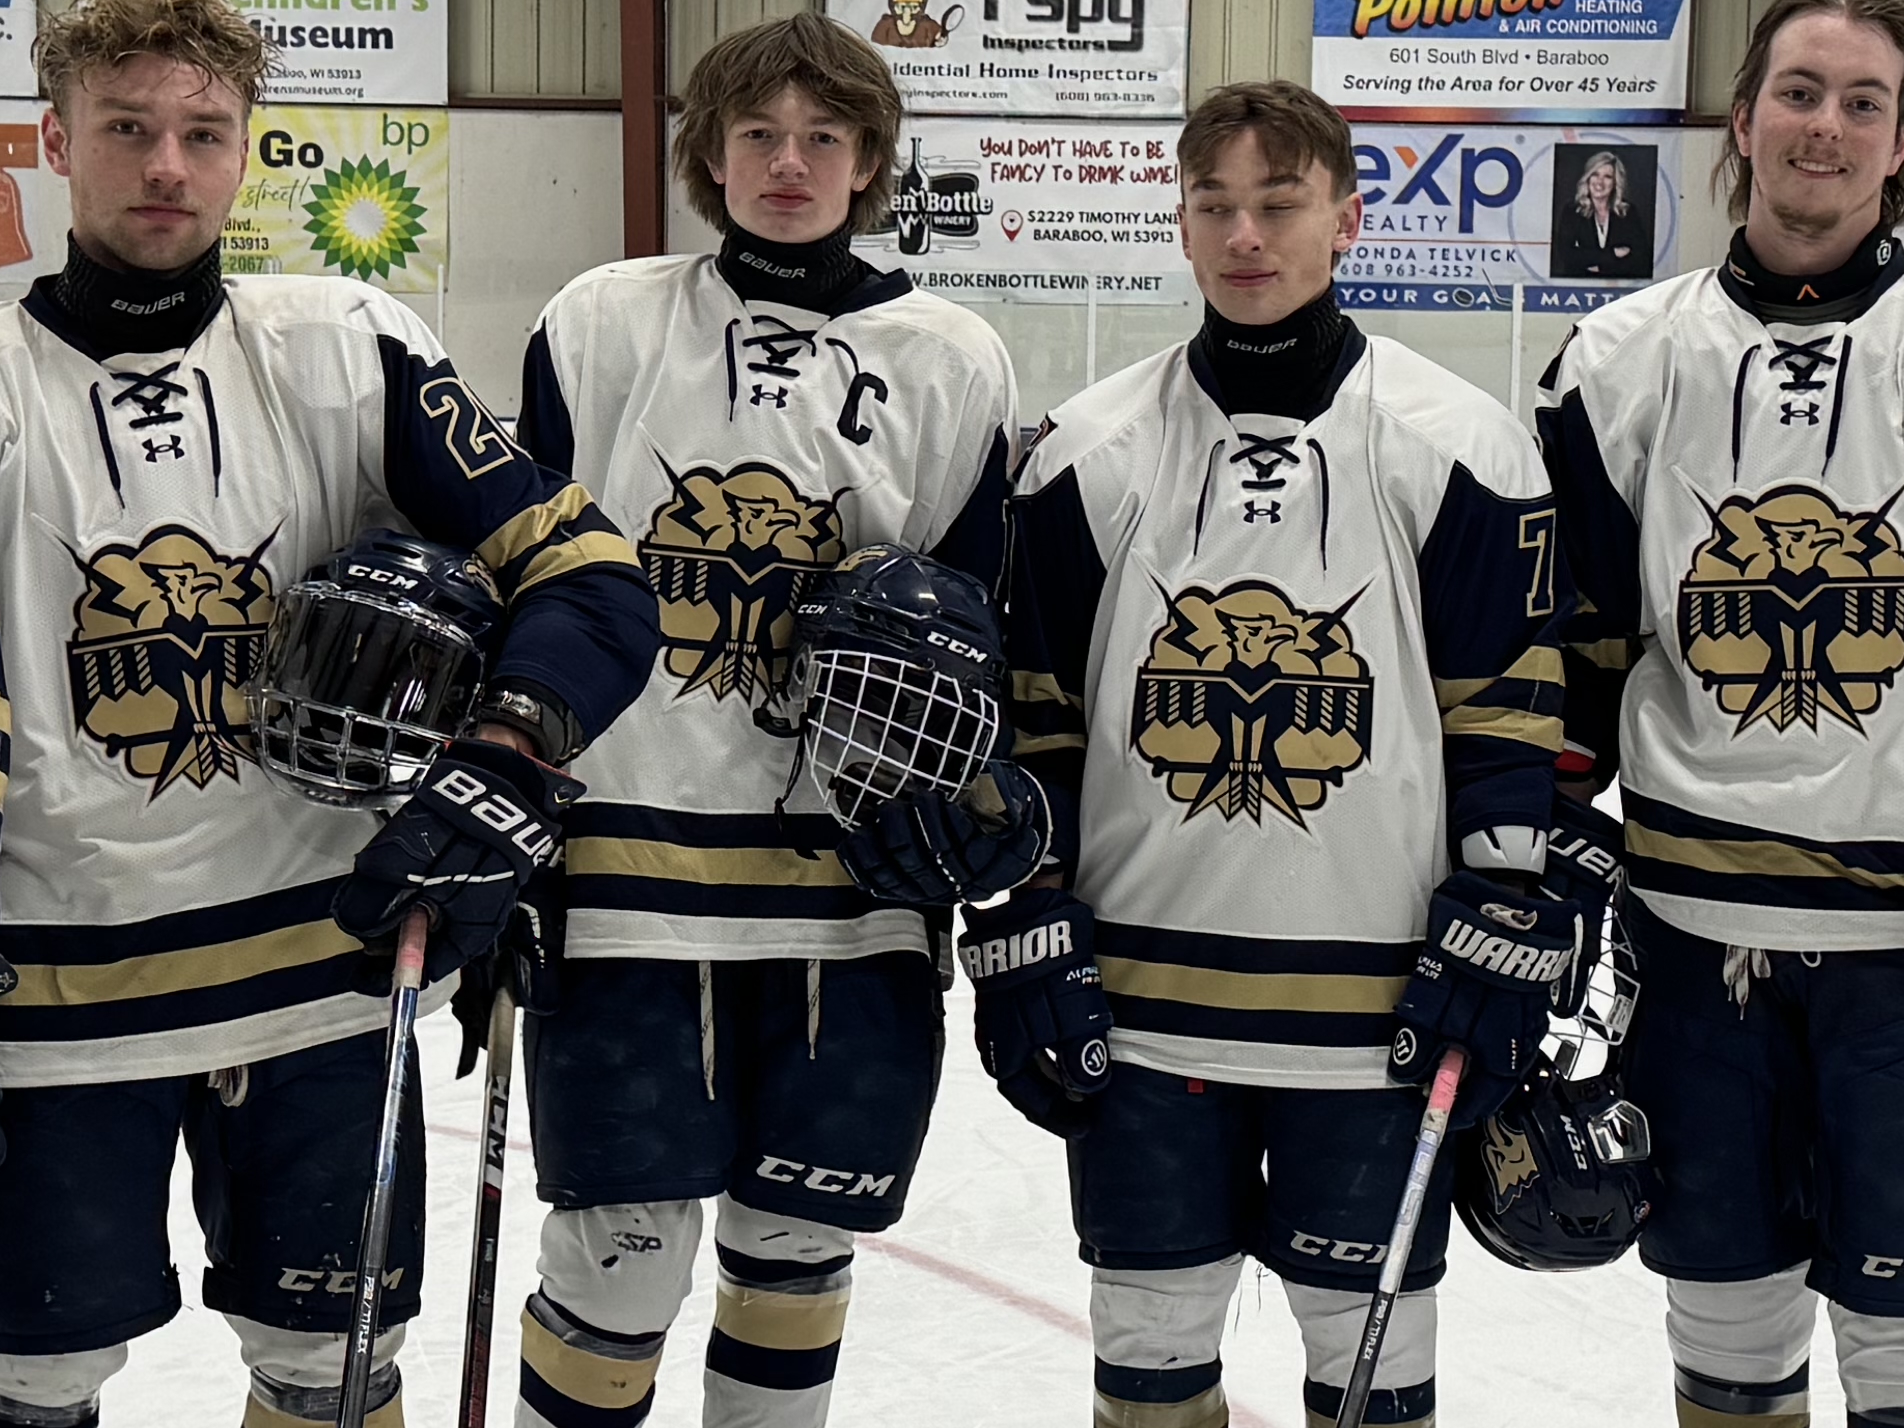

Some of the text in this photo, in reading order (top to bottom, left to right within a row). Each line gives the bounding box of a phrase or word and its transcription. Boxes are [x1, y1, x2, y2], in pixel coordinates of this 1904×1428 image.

[1575, 0, 1643, 14] HEATING
[1498, 19, 1658, 35] & AIR CONDITIONING
[982, 34, 1108, 52] Inspectors
[1389, 48, 1609, 66] 601 South Blvd Baraboo
[979, 62, 1158, 83] Home Inspectors
[1343, 74, 1658, 94] Serving the Area for Over 45 Years
[382, 113, 430, 155] bp
[259, 130, 324, 169] Go
[1072, 140, 1113, 159] HAVE
[1147, 140, 1165, 159] BE
[991, 163, 1045, 183] FANCY
[1079, 164, 1124, 184] DRINK
[1353, 133, 1524, 234] exp
[926, 191, 993, 215] Bottle
[1079, 211, 1141, 224] TIMOTHY
[1363, 214, 1448, 232] EALTY
[230, 237, 269, 250] 53913
[1033, 229, 1108, 244] BARABOO,
[1111, 231, 1130, 242] WI
[1428, 248, 1517, 263] TELVICK
[1340, 265, 1475, 278] 608 963-4252
[1340, 287, 1418, 304] YOUR
[837, 371, 889, 446] C
[1518, 507, 1557, 618] 7
[348, 564, 419, 590] CCM
[797, 604, 828, 615] CCM
[926, 631, 988, 663] CCM
[1560, 1114, 1587, 1171] CCM
[756, 1155, 896, 1198] CCM
